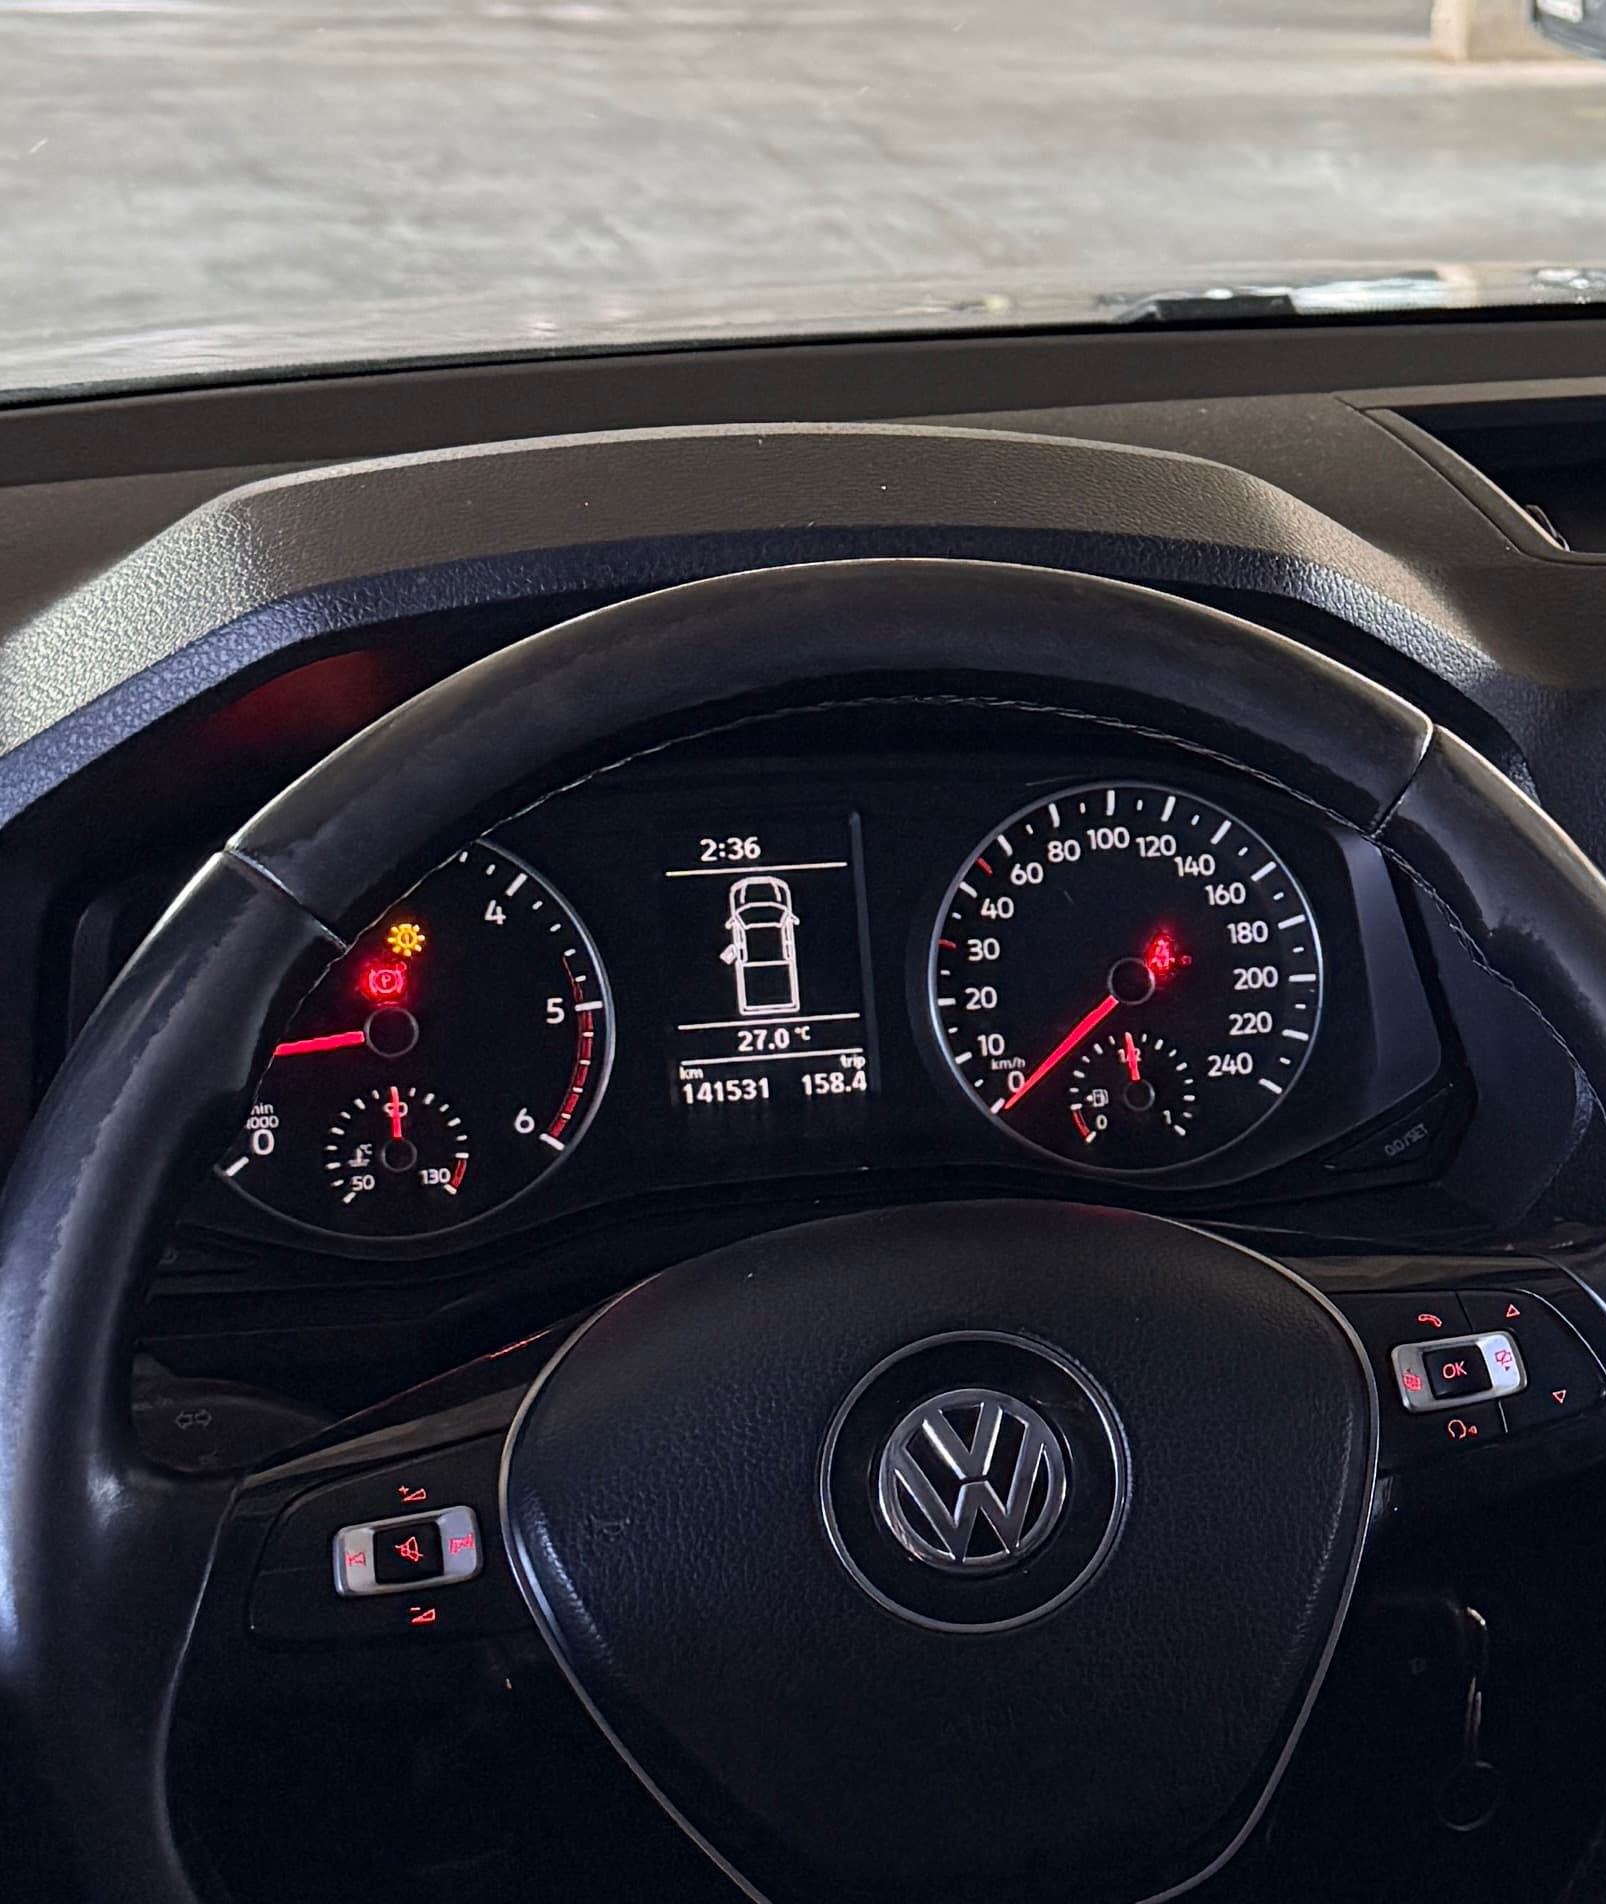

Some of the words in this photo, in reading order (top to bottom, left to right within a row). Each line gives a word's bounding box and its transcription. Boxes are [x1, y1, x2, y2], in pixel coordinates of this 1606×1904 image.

[700, 836, 761, 862] 2:36
[1086, 826, 1130, 850] 100
[1136, 834, 1177, 858] 120
[1047, 839, 1081, 863] 80
[1010, 862, 1044, 886] 60
[1174, 853, 1216, 877] 140
[1204, 882, 1246, 906] 160
[484, 899, 506, 925] 4
[980, 896, 1014, 919] 40
[1227, 921, 1269, 945] 180
[967, 938, 1000, 962] 30
[1232, 966, 1278, 991] 200
[965, 986, 998, 1010] 20
[546, 997, 565, 1024] 5
[1228, 1011, 1273, 1036] 220
[737, 1028, 790, 1052] 27.0
[977, 1033, 1005, 1057] 10
[679, 1066, 704, 1080] km
[840, 1054, 866, 1070] trip
[991, 1057, 1026, 1071] km/h
[1207, 1052, 1253, 1078] 240
[683, 1078, 769, 1104] 141531
[802, 1071, 867, 1096] 158.4
[1008, 1070, 1026, 1093] 0
[514, 1107, 535, 1134] 6
[1096, 1114, 1108, 1130] 0
[1163, 1110, 1172, 1125] 1
[253, 1128, 275, 1155] 0
[351, 1174, 375, 1192] 50
[420, 1167, 451, 1185] 130
[1442, 1360, 1467, 1379] OK
